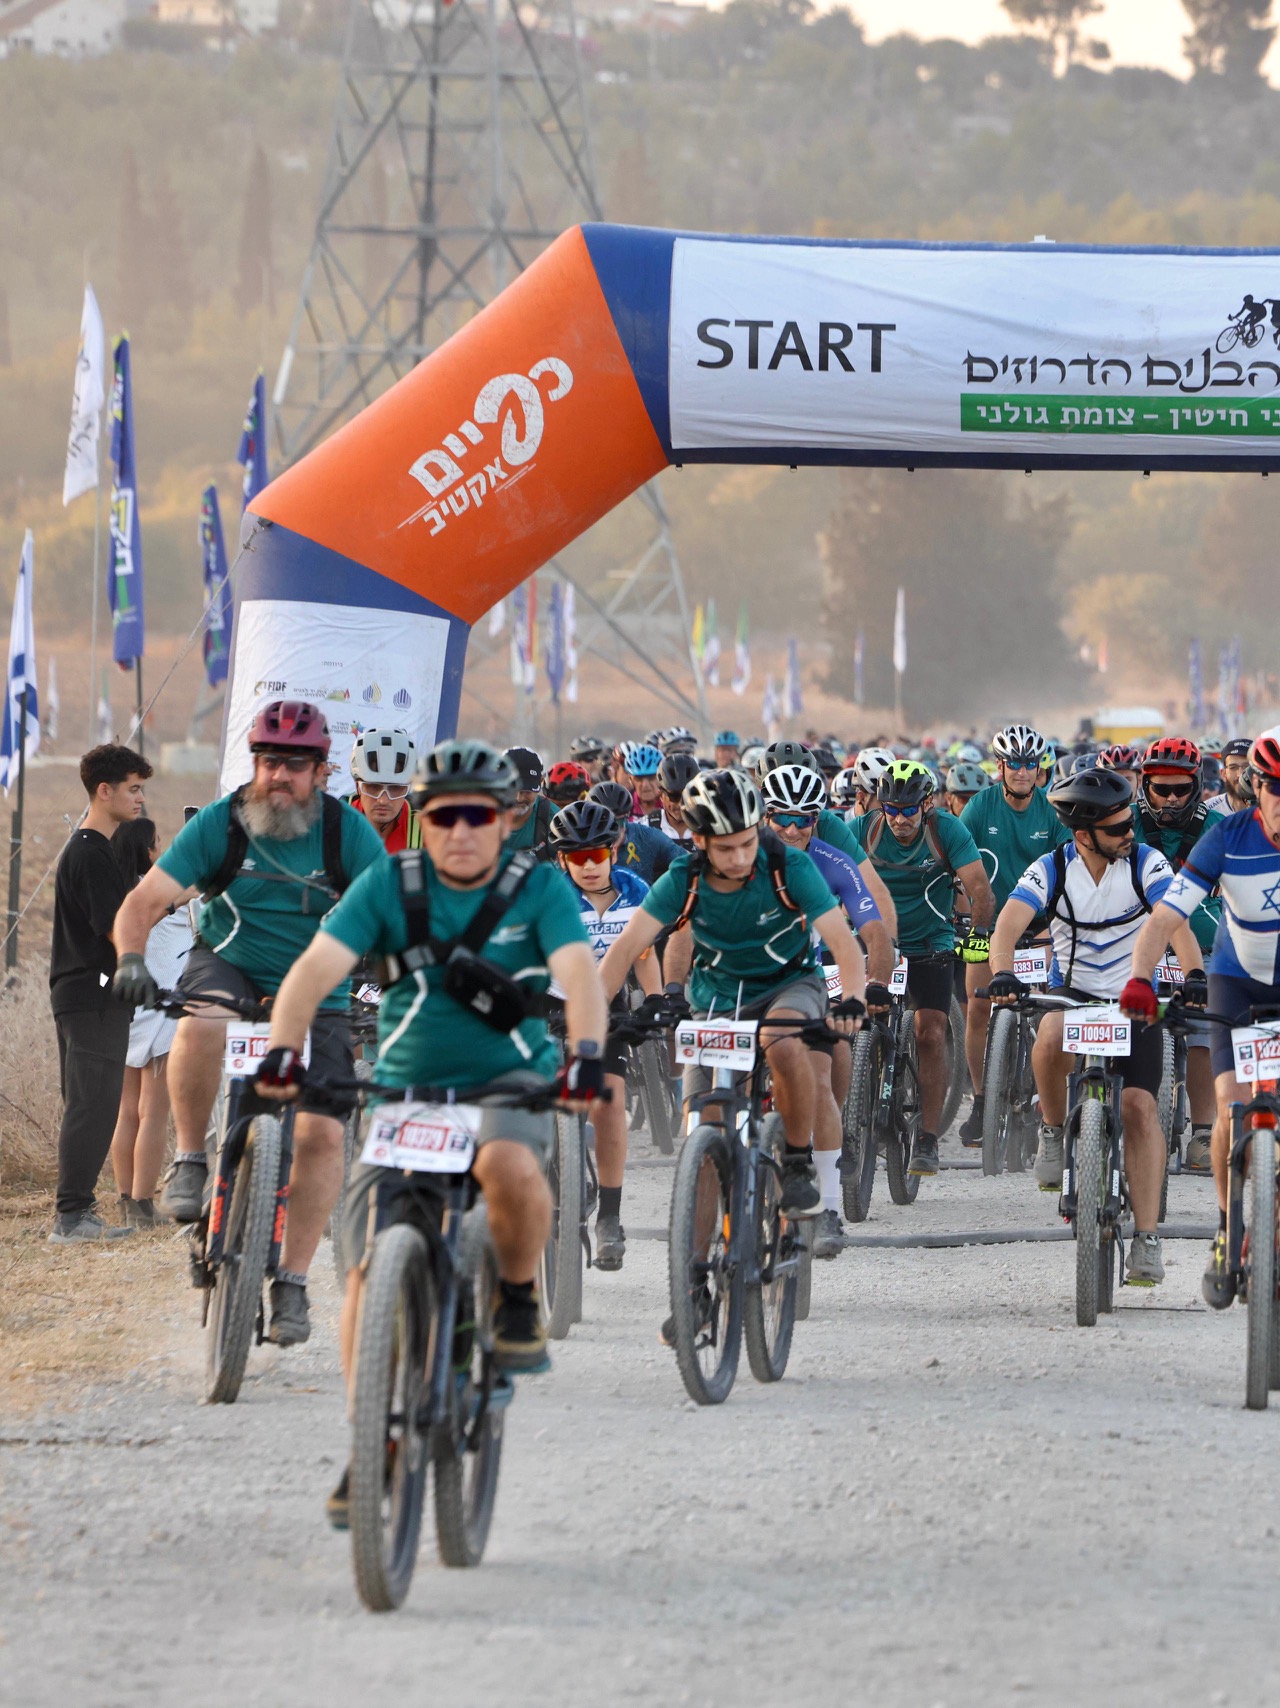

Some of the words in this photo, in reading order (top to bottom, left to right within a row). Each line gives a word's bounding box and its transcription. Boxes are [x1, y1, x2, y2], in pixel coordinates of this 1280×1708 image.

[697, 318, 897, 373] START
[962, 349, 1132, 386] הדרוזים
[976, 401, 1050, 425] גולני
[1060, 406, 1135, 426] צומת
[1170, 408, 1248, 430] חיטין
[408, 357, 574, 498] כפיים
[422, 456, 508, 537] אקטיב
[267, 681, 287, 692] FIDF
[843, 863, 862, 895] creation
[587, 922, 629, 936] ADEMY
[969, 940, 990, 951] FOX
[1013, 961, 1031, 973] 0383
[1083, 1026, 1111, 1042] 10094
